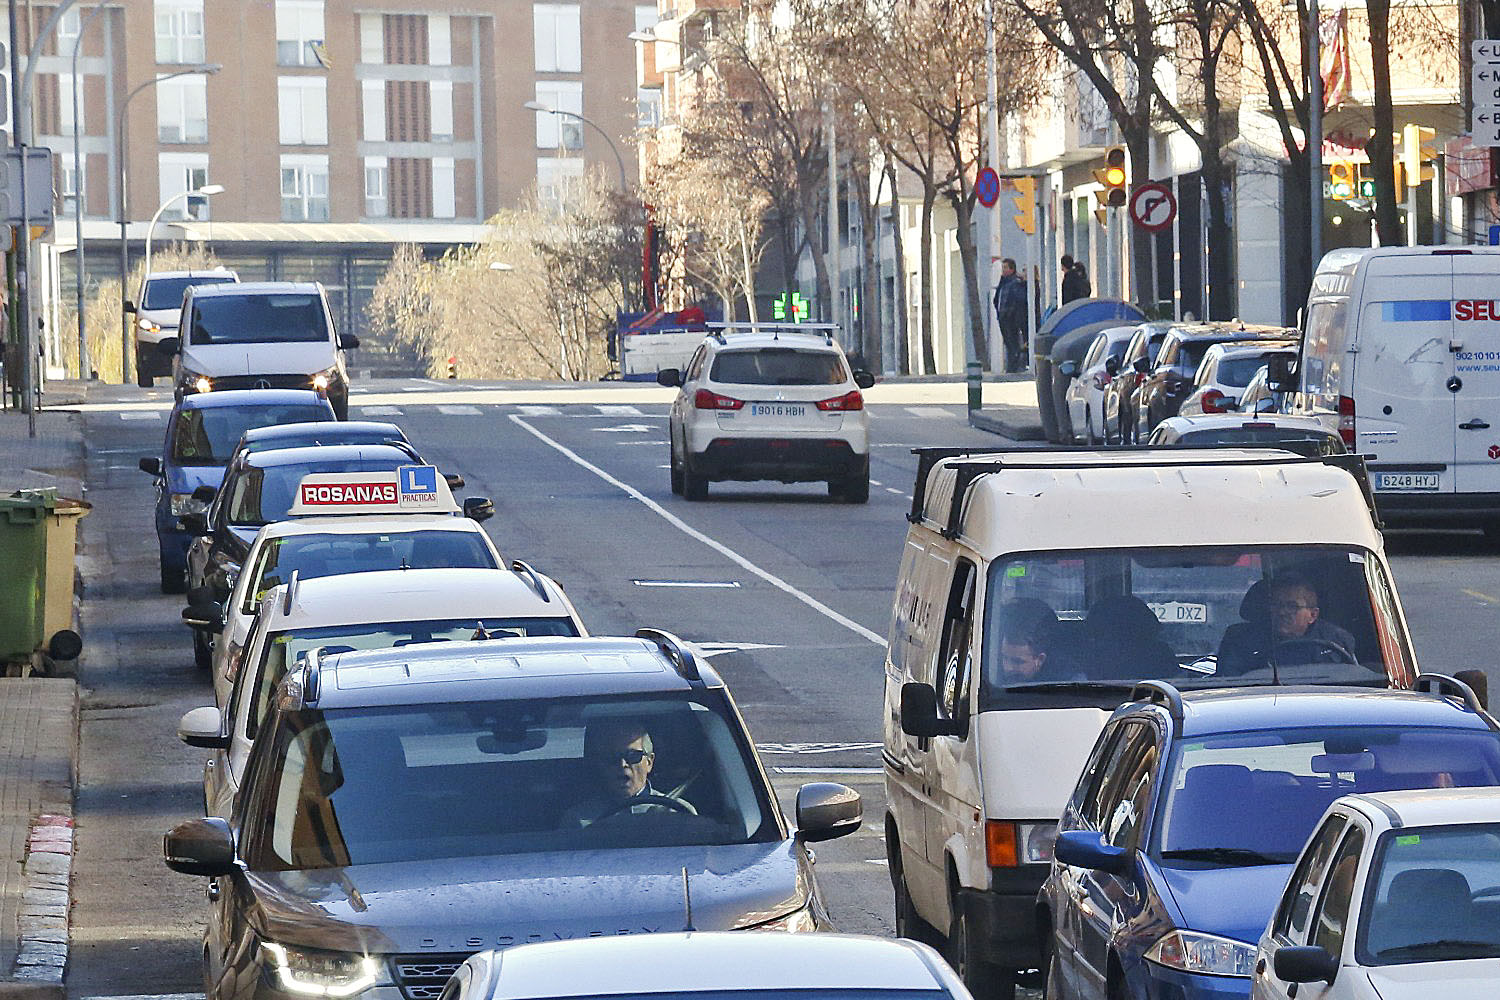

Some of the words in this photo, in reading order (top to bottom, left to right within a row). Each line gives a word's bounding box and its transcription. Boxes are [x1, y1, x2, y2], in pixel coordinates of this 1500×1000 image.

[1384, 476, 1411, 486] 6248
[1416, 476, 1436, 486] HYJ
[305, 486, 395, 502] ROSANAS
[1177, 607, 1202, 620] DXZ
